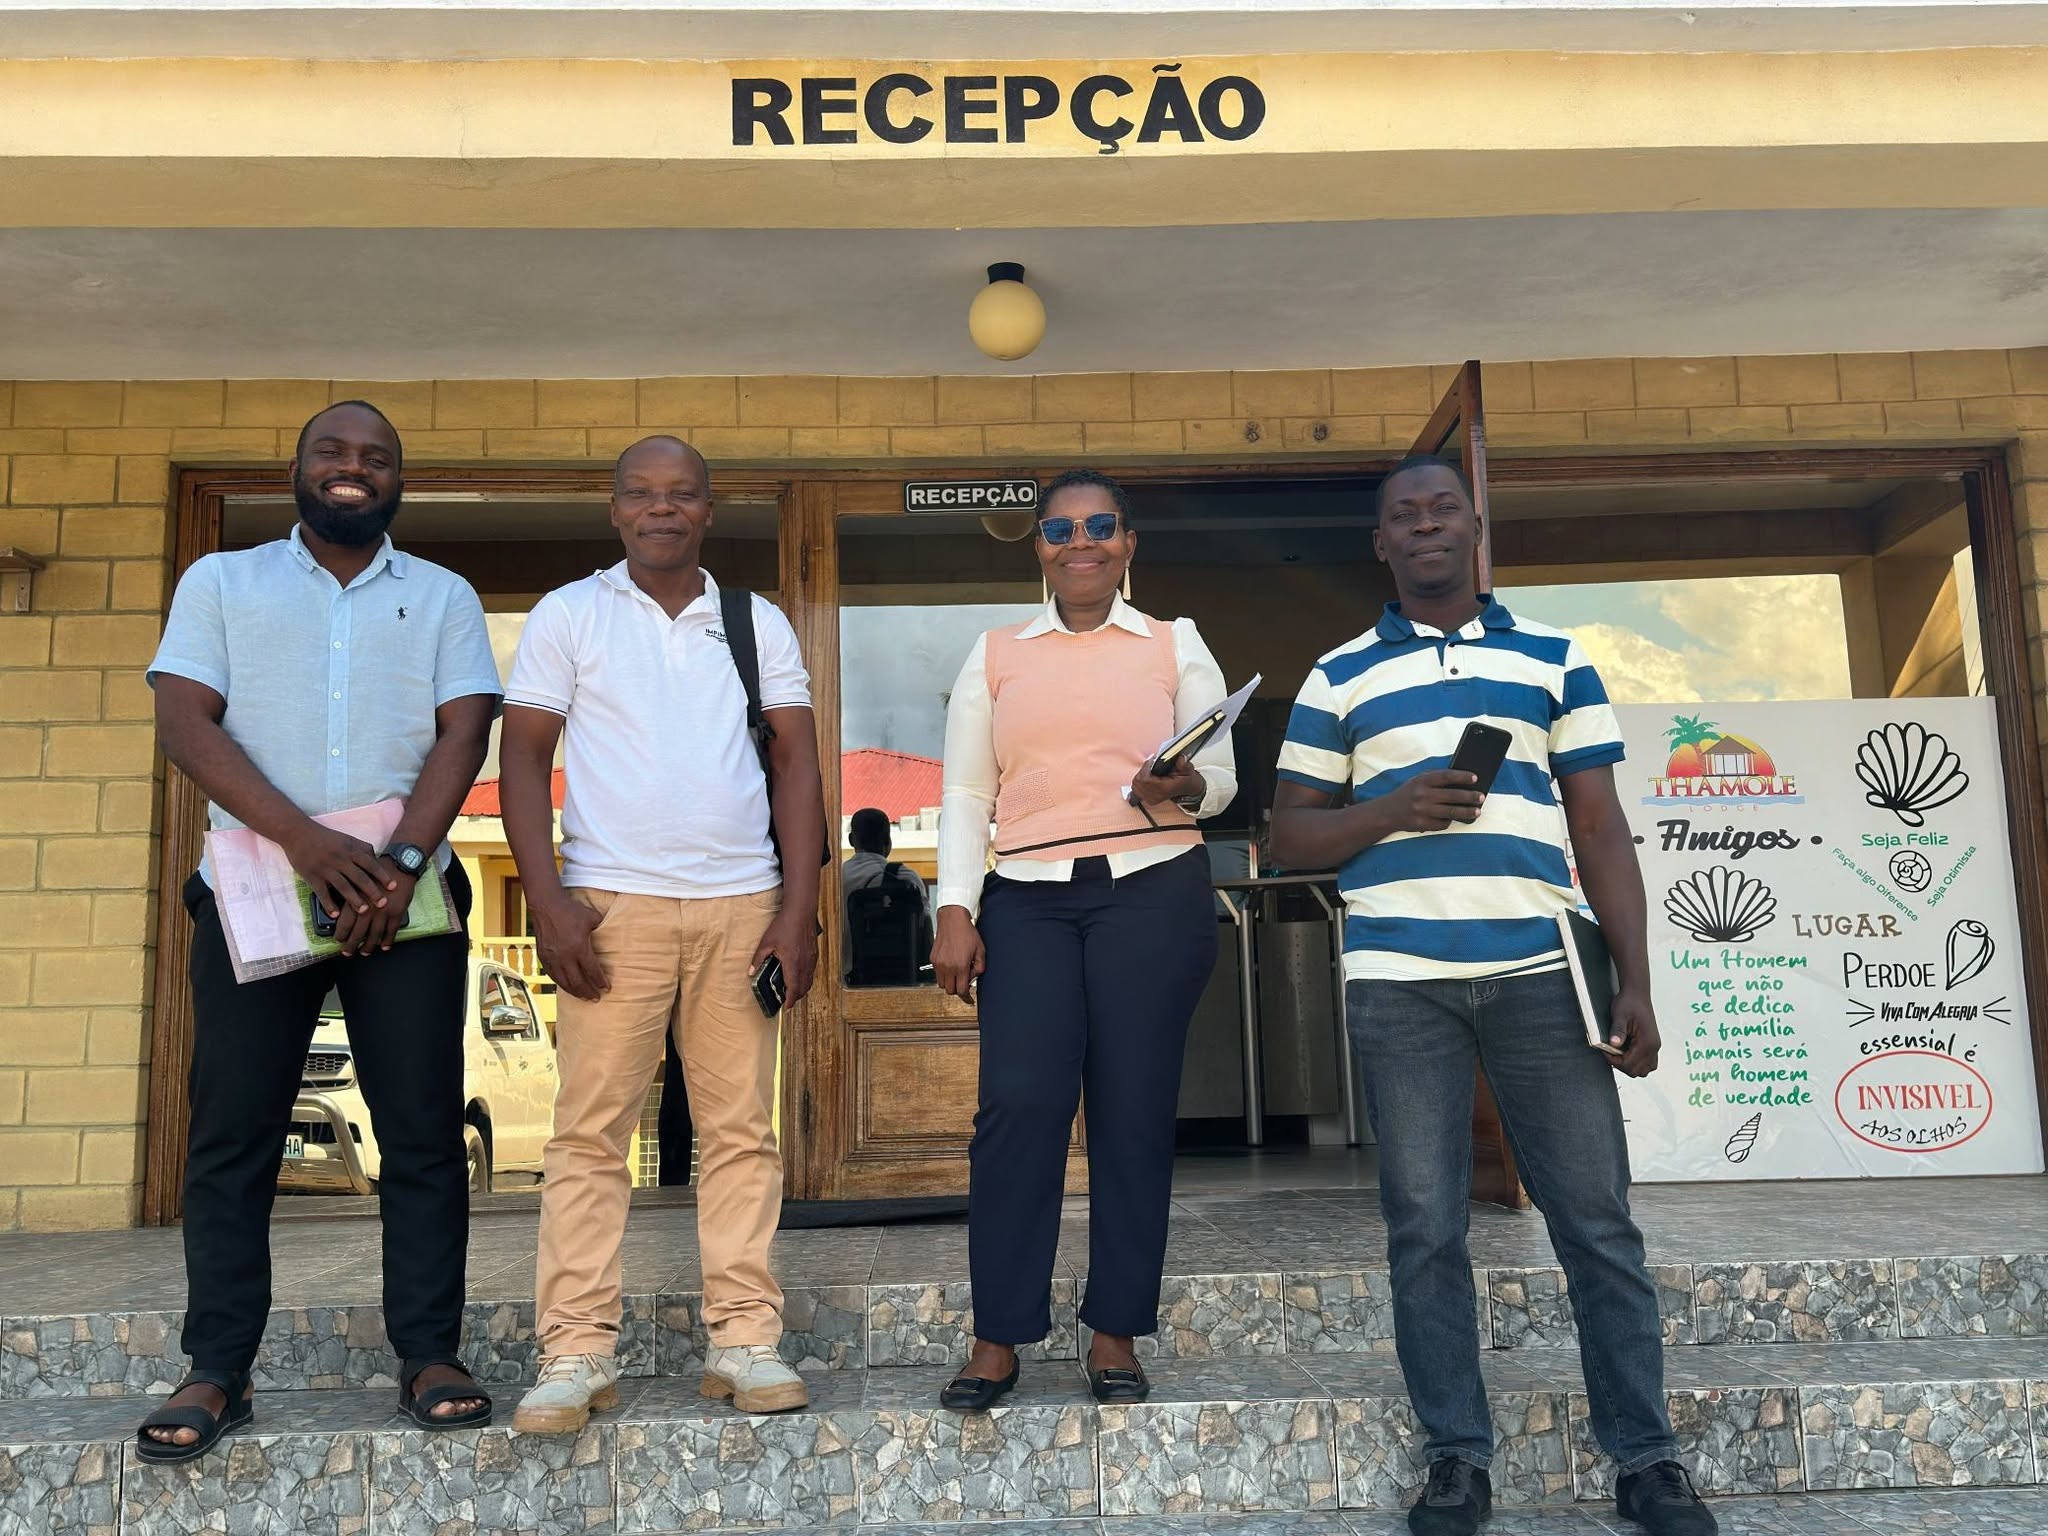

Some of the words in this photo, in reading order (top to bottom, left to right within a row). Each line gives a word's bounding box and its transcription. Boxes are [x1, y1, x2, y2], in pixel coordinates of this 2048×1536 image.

[731, 62, 1266, 154] RECEPÇÃO
[911, 484, 1034, 506] RECEPÇÃO
[1648, 775, 1797, 797] THAMOLE
[1657, 819, 1800, 860] Amigos
[1861, 833, 1903, 849] Seja
[1907, 832, 1949, 846] Feliz
[1832, 848, 1856, 870] Faça
[1856, 867, 1877, 887] algo
[1876, 883, 1919, 922] Diferente
[1927, 886, 1947, 907] Seja
[1943, 845, 1977, 885] Otimista
[1792, 913, 1903, 938] LUGAR
[1670, 950, 1710, 969] Um
[1721, 949, 1808, 969] Homem
[1843, 952, 1936, 988] PERDOE
[1698, 978, 1735, 997] que
[1745, 975, 1784, 991] não
[1691, 1001, 1714, 1013] se
[1724, 995, 1795, 1015] dedica
[1718, 1017, 1795, 1041] família
[1685, 1041, 1753, 1065] jamais
[1763, 1042, 1809, 1058] será
[1860, 1028, 1956, 1056] essensial
[1964, 1043, 1978, 1062] é
[1689, 1071, 1720, 1083] um
[1731, 1063, 1808, 1082] homem
[1688, 1086, 1716, 1107] de
[1725, 1085, 1813, 1106] verdade
[1858, 1084, 1982, 1110] INVISIVEL
[1861, 1120, 1902, 1142] AOS
[1906, 1116, 1967, 1144] OLHOS
